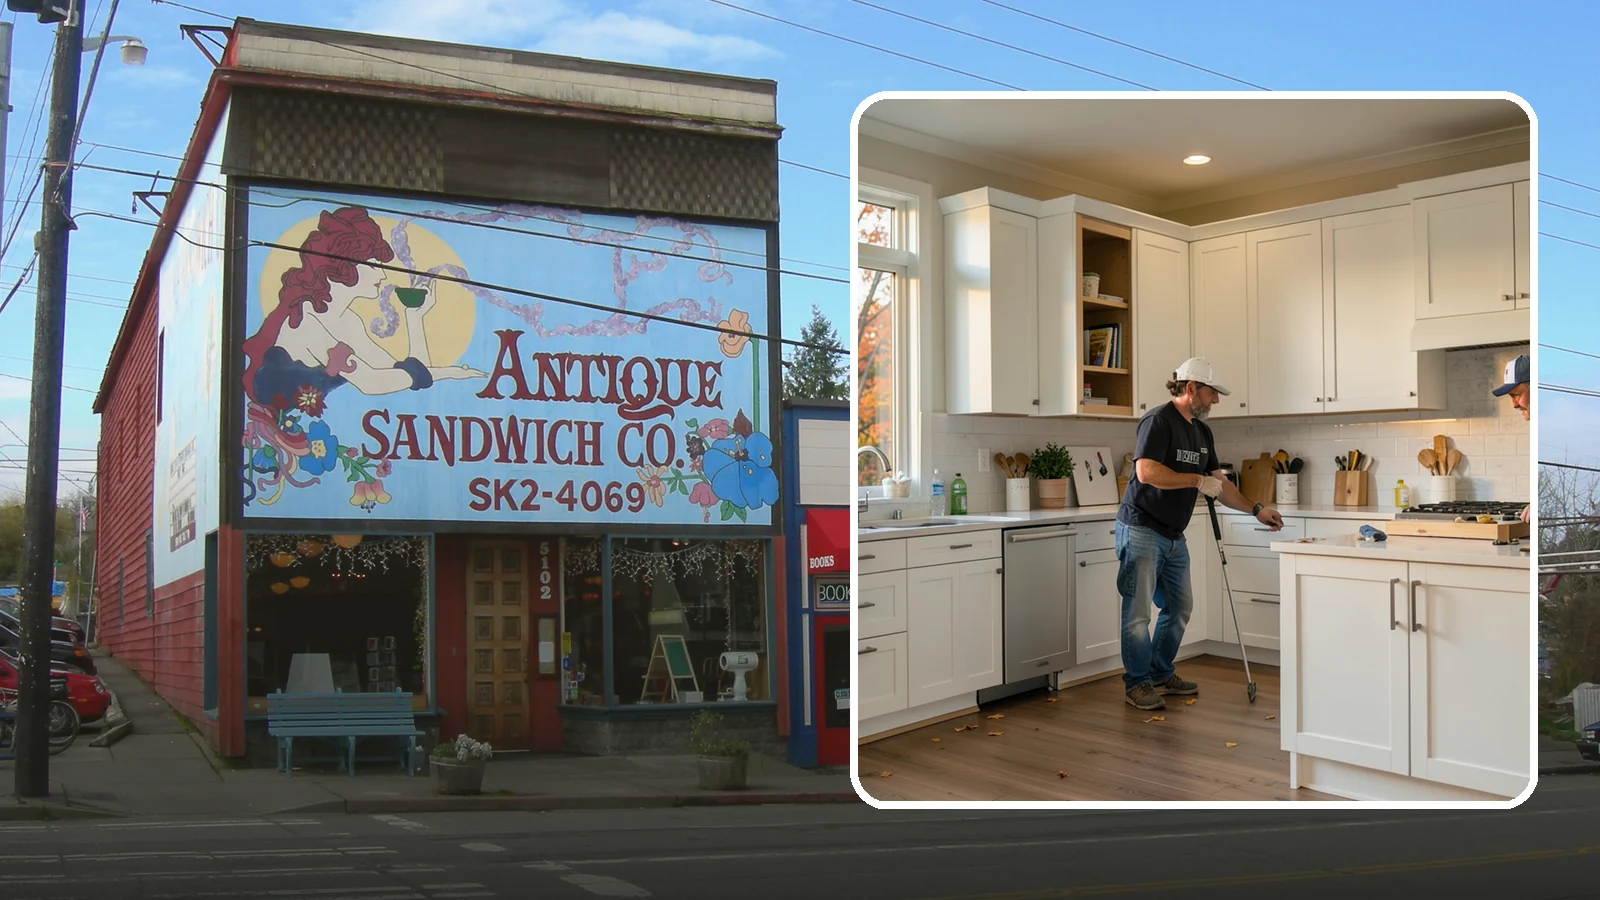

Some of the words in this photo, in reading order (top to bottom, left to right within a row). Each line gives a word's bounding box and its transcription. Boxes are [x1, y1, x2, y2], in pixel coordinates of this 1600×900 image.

[476, 330, 723, 420] ANTIQUE
[361, 408, 605, 467] SANDWICH
[617, 422, 686, 469] CO.
[468, 478, 646, 513] SK2-4069
[540, 541, 552, 600] 5102
[809, 555, 834, 568] BOOKS
